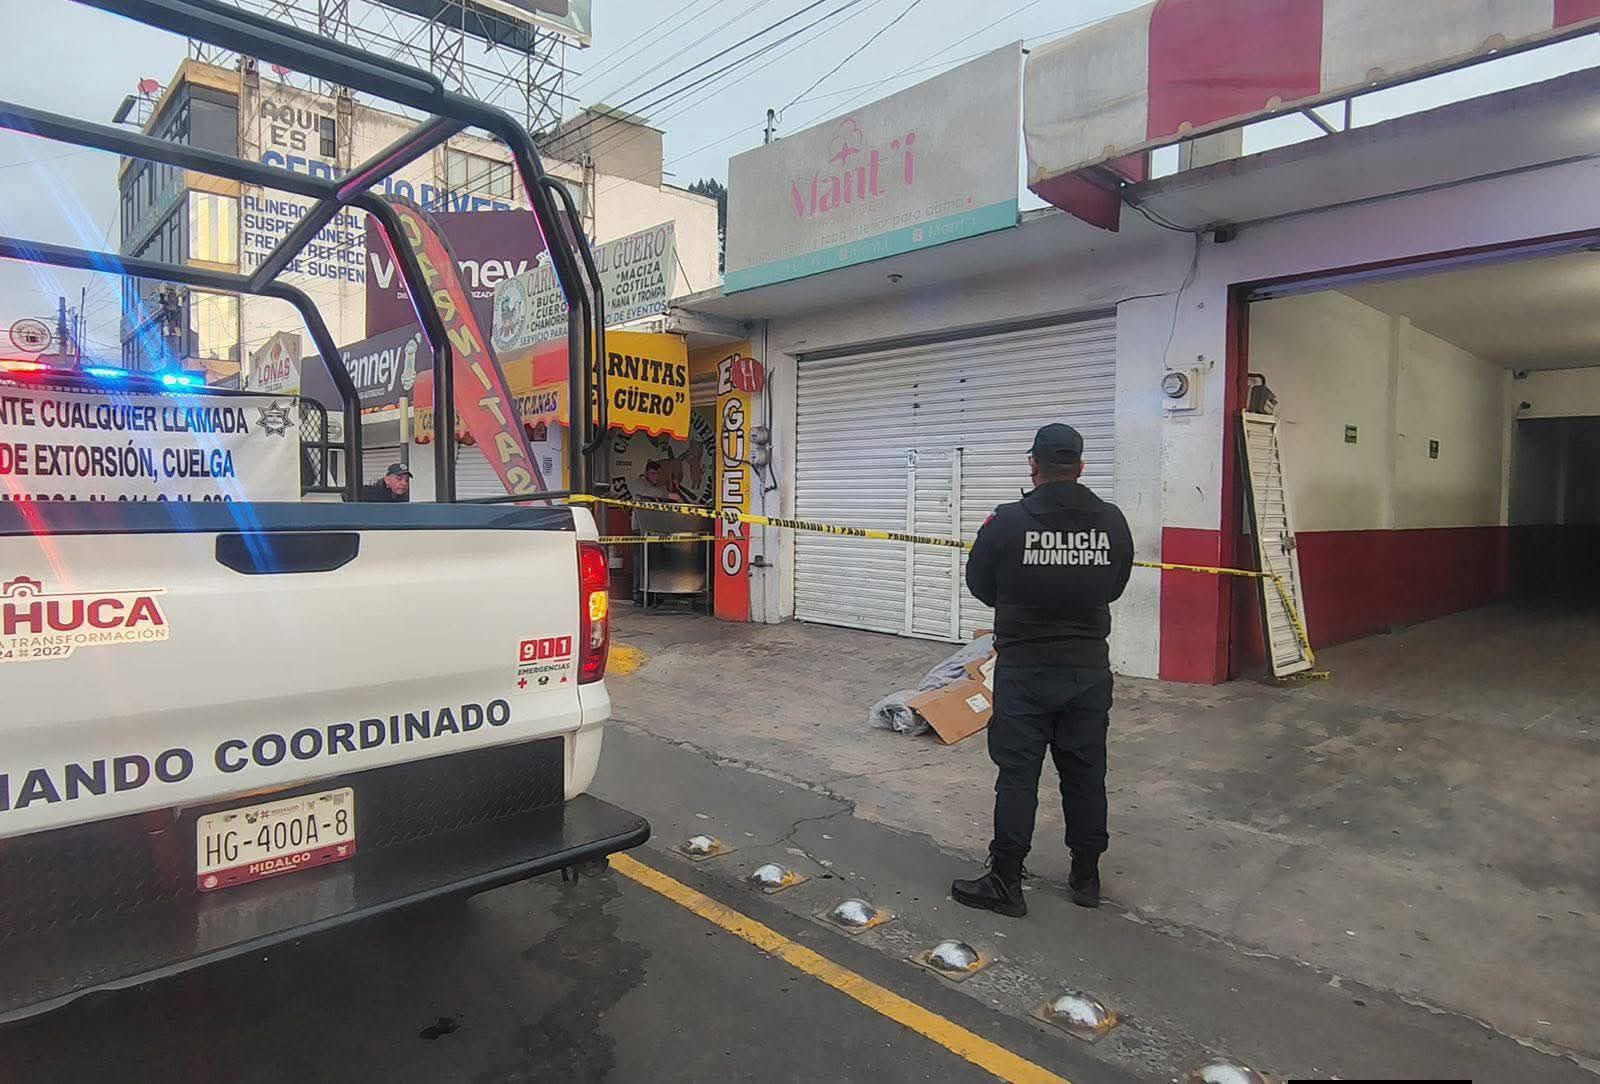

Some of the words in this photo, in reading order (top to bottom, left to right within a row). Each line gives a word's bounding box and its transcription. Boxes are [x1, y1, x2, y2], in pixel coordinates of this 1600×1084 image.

[271, 124, 306, 151] ES
[308, 244, 364, 265] REFACC
[308, 261, 364, 283] SUSPEN
[620, 261, 661, 283] MACIZA
[614, 272, 665, 296] COSTILLA
[626, 301, 667, 320] EVENTOS
[530, 313, 568, 333] CHAMORR
[593, 352, 686, 388] RNITAS
[40, 400, 157, 431] CUALQUIER
[163, 407, 249, 433] LLAMADA
[35, 440, 158, 482] EXTORSIÓN,
[163, 448, 235, 478] CUELGA
[1024, 531, 1110, 550] POLICÍA
[1022, 549, 1111, 566] MUNICIPAL
[11, 628, 166, 648] TRANSFORMACIÓN
[523, 638, 568, 660] 911
[32, 645, 72, 657] 2027
[518, 663, 570, 676] EMERGENCIAS
[214, 699, 511, 774] COORDINADO
[205, 809, 349, 867] HG-400A-8
[249, 852, 312, 876] HIDALGO
